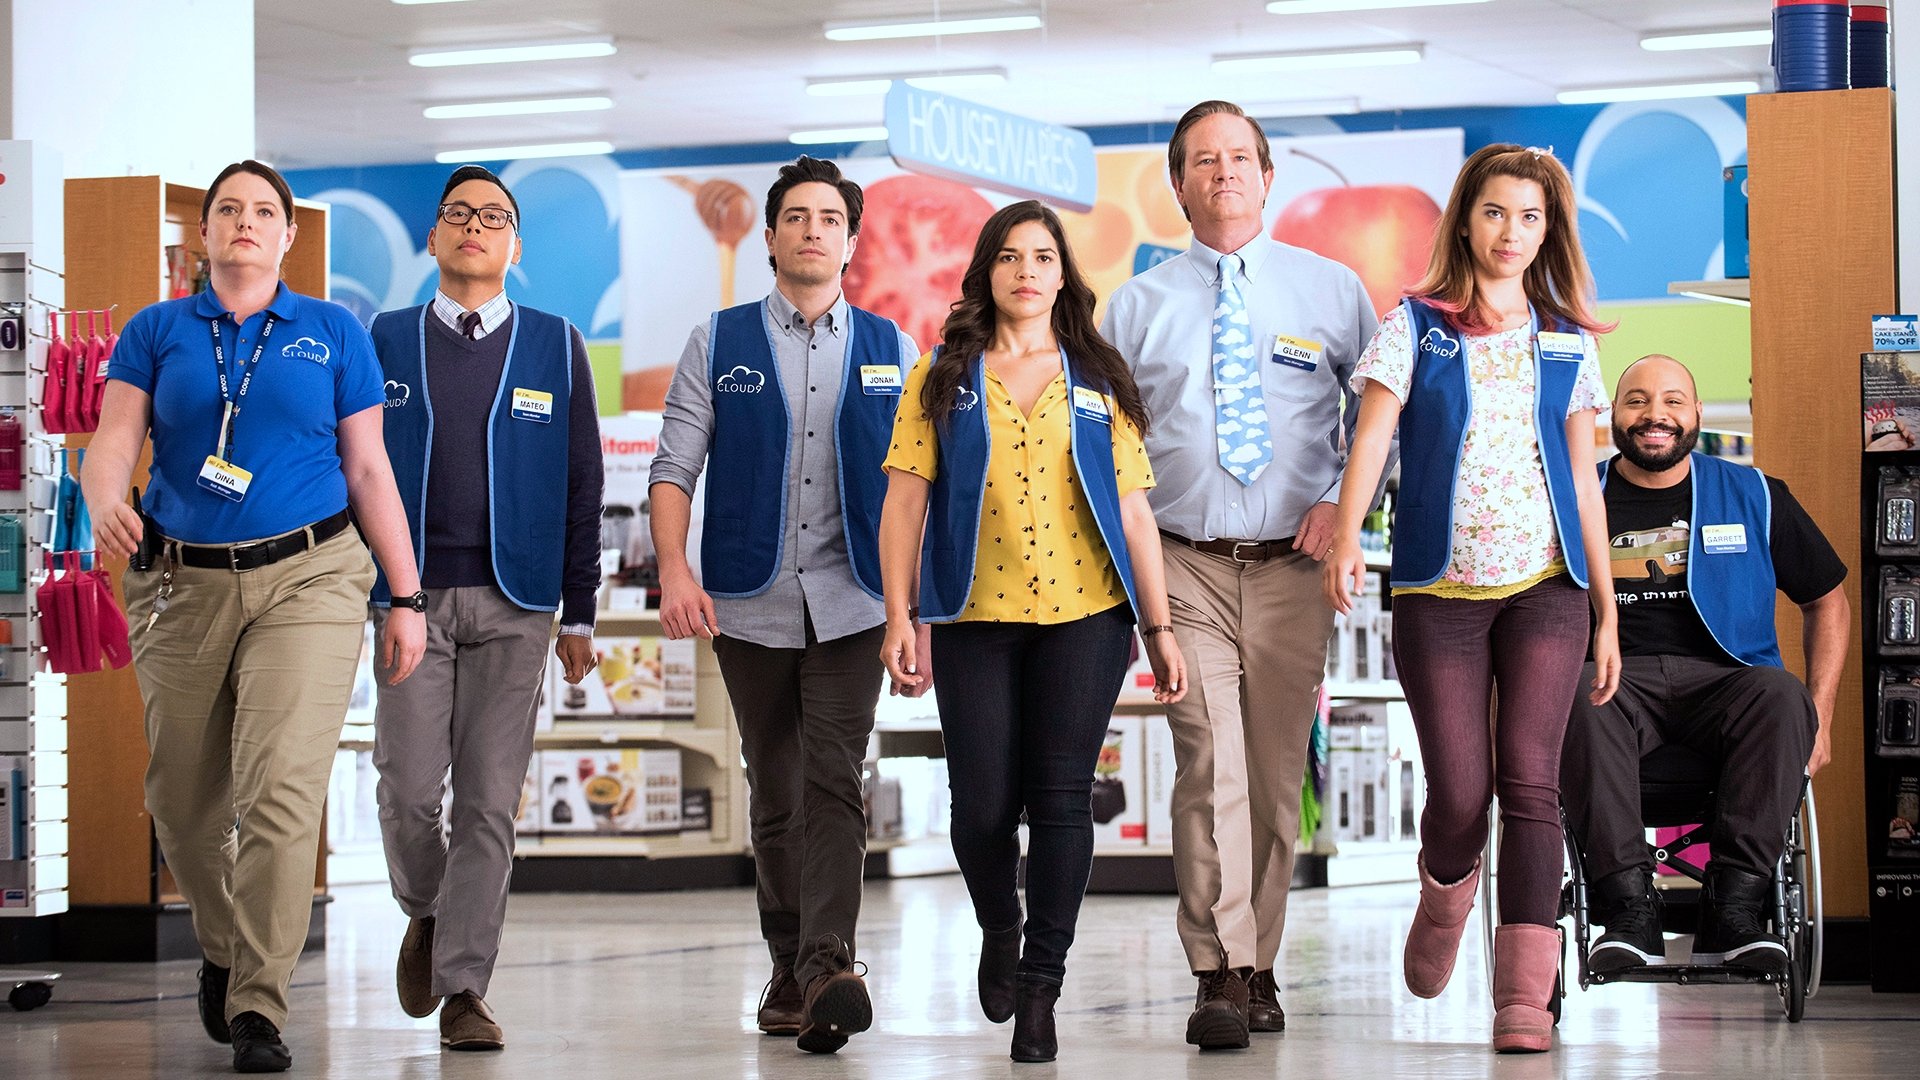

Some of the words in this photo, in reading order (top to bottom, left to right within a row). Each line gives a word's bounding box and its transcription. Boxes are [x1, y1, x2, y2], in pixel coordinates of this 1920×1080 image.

[907, 92, 1078, 196] HOUSEWARES
[1897, 337, 1916, 345] OFF
[1282, 346, 1311, 360] GLENN
[1420, 342, 1456, 359] COUD9
[282, 351, 328, 365] CLOUD9
[717, 383, 762, 394] CLOUD9
[383, 398, 408, 409] OUD9
[520, 400, 545, 411] MATEO
[601, 434, 657, 455] itami
[214, 472, 236, 486] DINA
